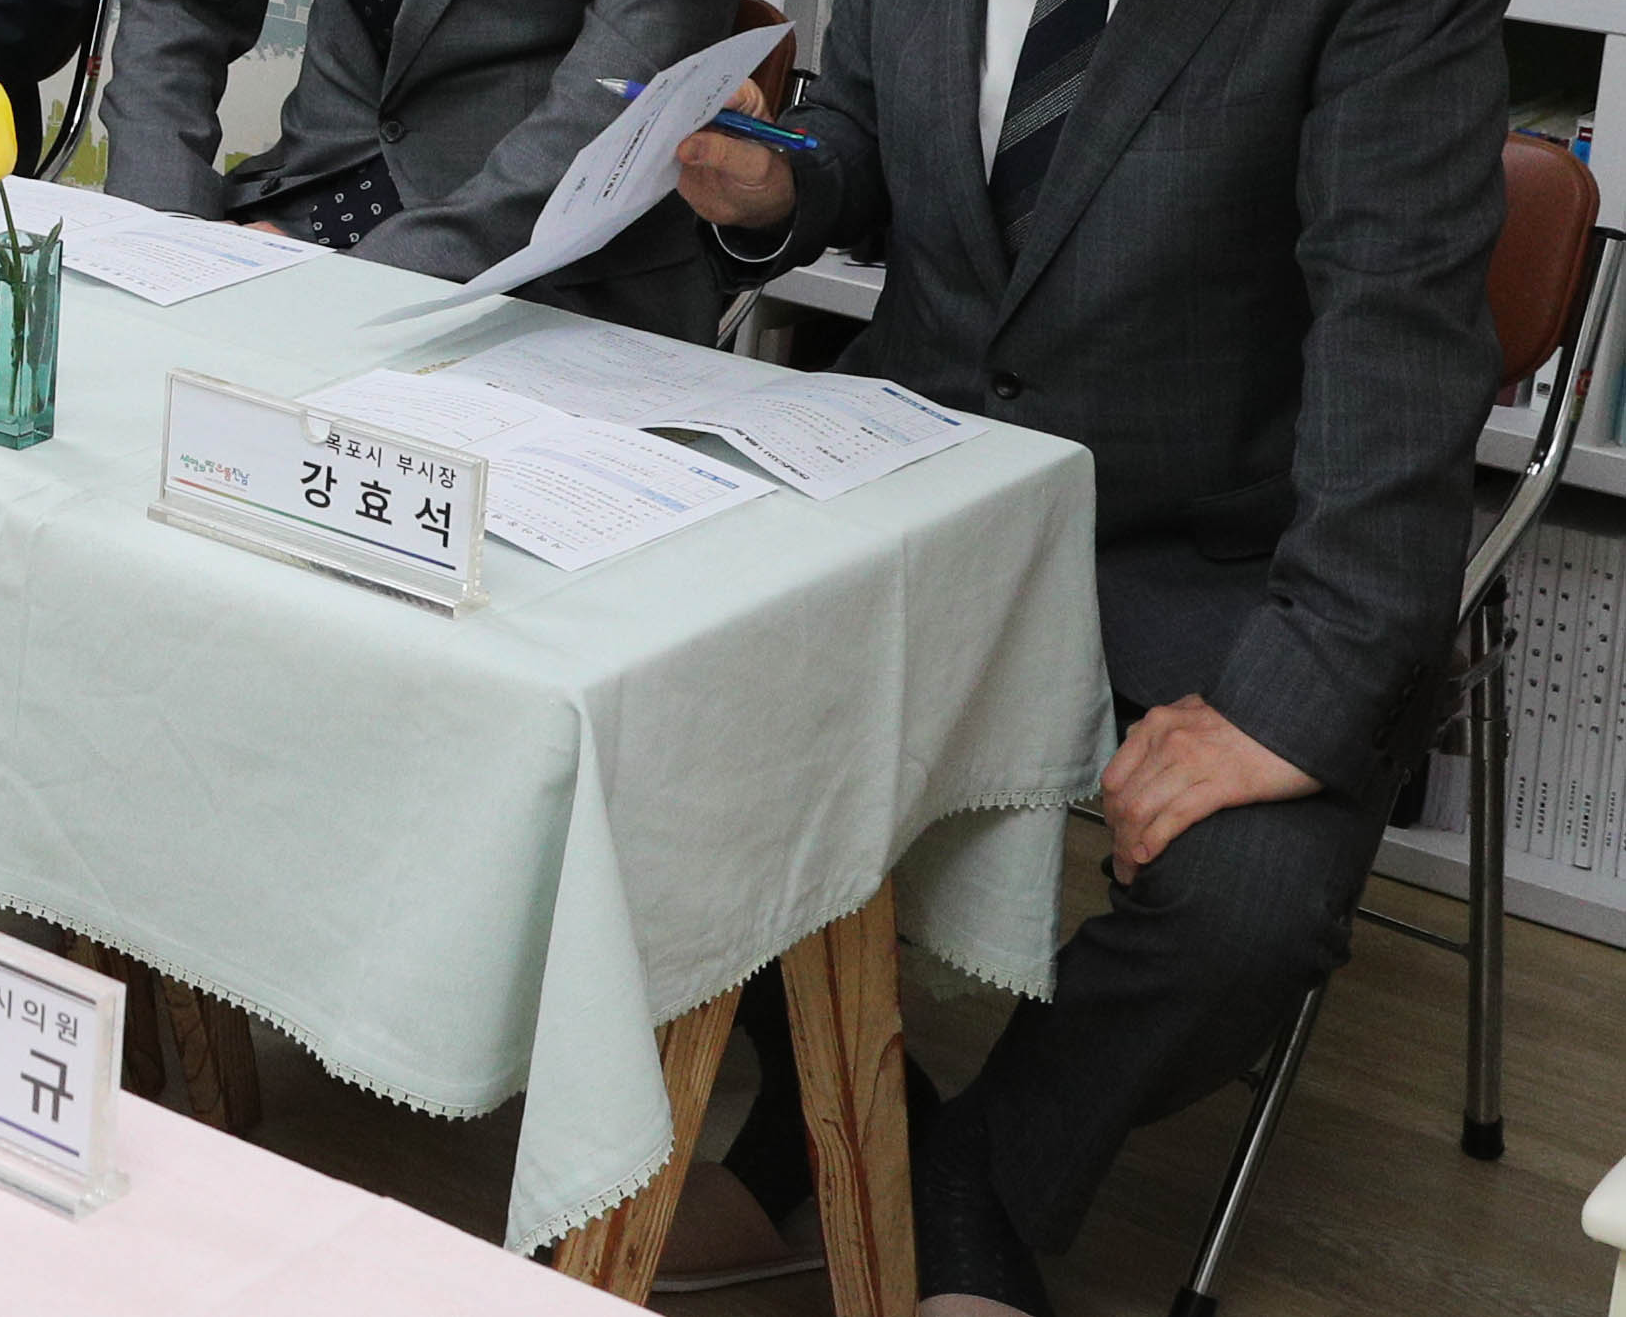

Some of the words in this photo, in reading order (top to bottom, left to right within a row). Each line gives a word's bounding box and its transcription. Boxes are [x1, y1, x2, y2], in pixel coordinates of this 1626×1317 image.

[325, 433, 383, 467] 목포시
[396, 454, 457, 489] 부시장
[300, 461, 452, 548] 강효석
